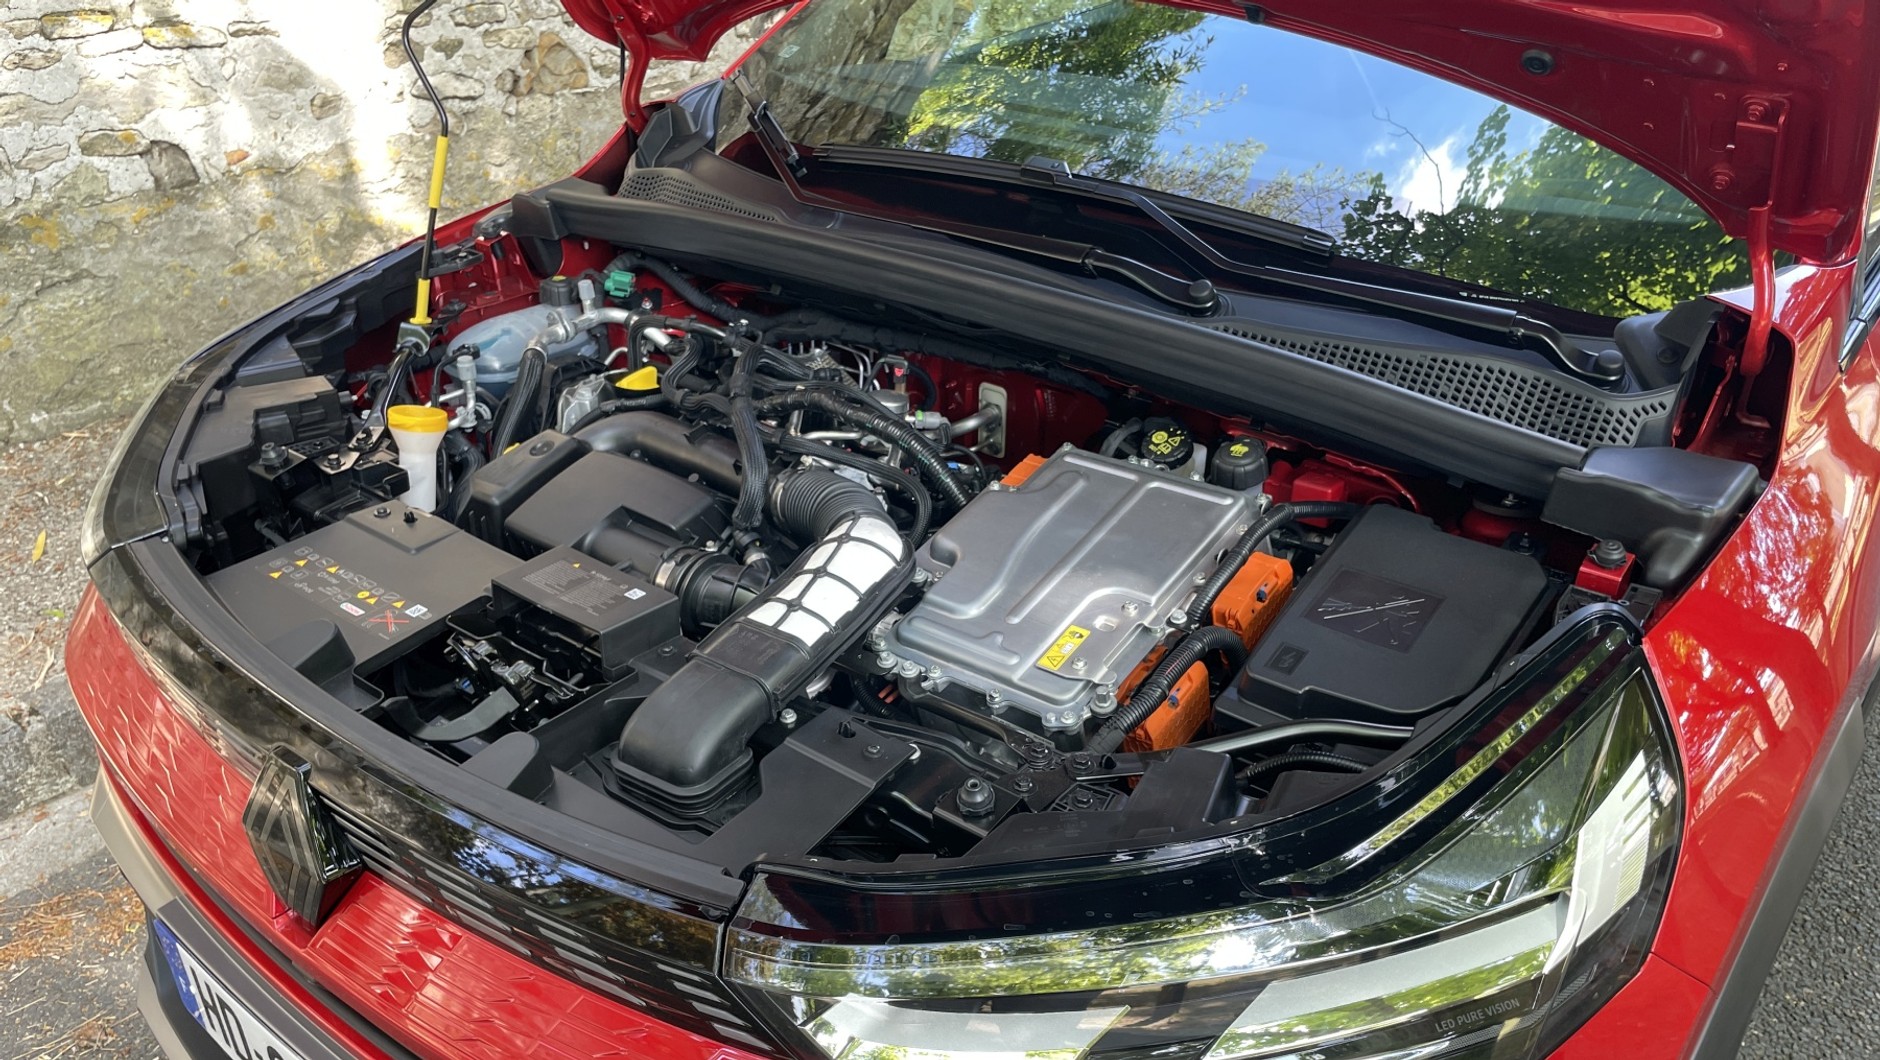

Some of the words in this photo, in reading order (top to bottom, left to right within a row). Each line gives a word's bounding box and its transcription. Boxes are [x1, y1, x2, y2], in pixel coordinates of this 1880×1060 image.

[1435, 1019, 1455, 1032] LED
[1456, 1009, 1485, 1026] PURE
[1485, 998, 1520, 1016] VISION
